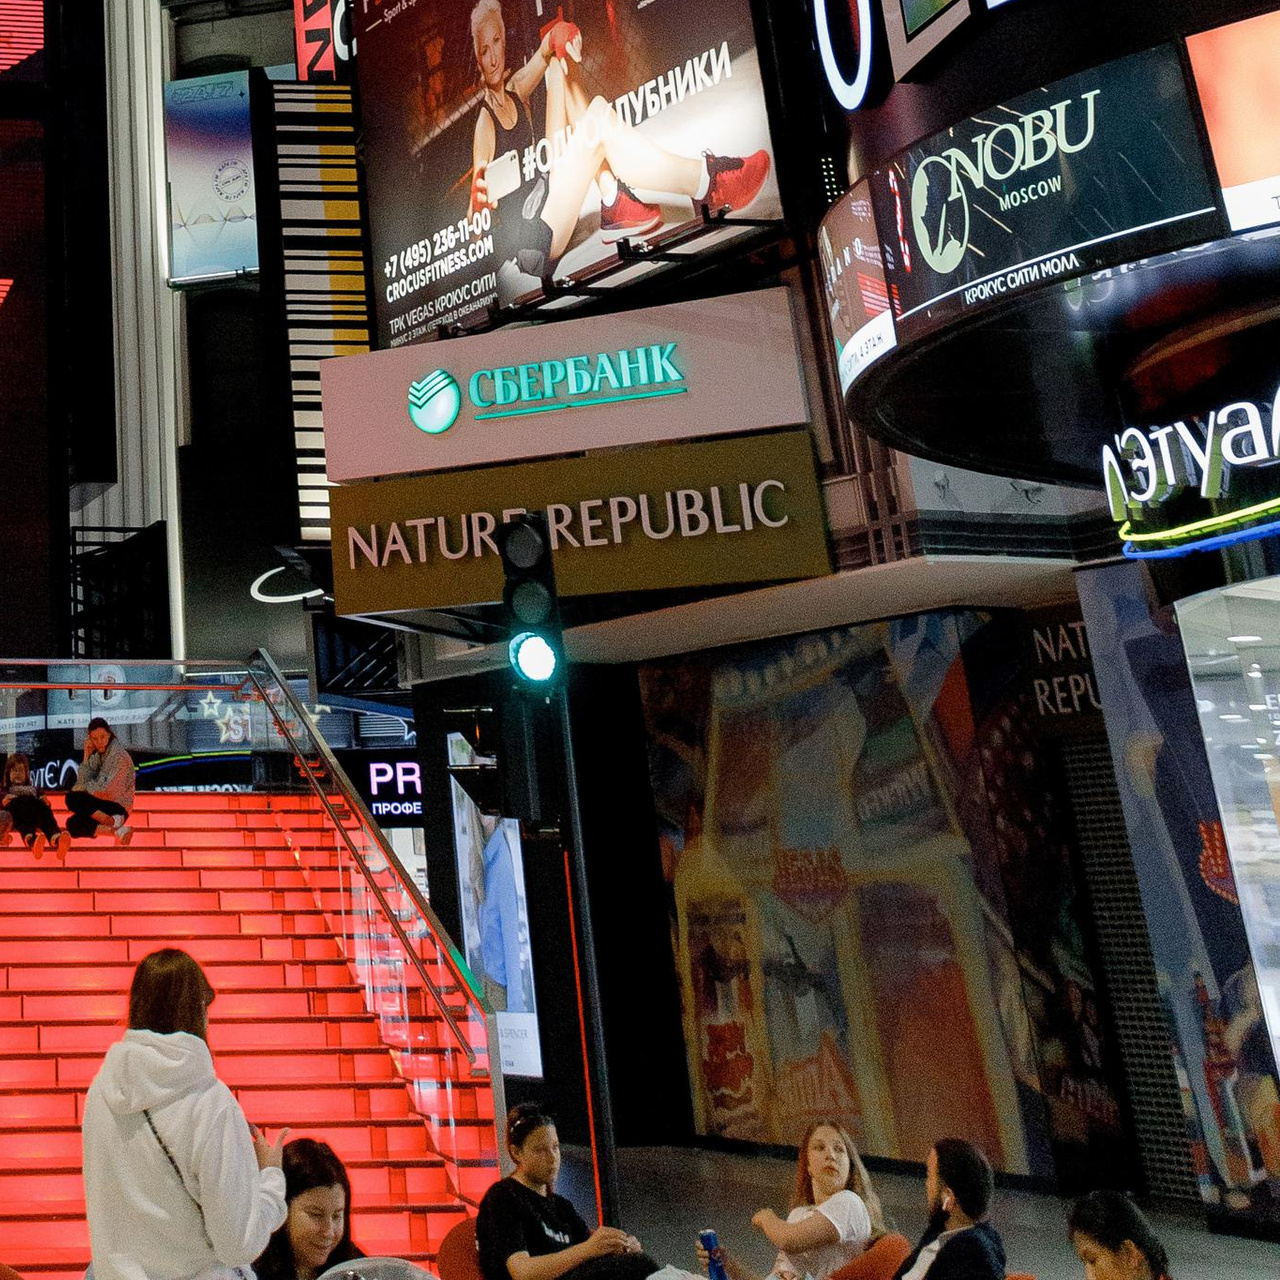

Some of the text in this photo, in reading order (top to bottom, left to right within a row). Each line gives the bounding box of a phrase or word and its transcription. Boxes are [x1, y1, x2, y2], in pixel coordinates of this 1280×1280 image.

[384, 2, 401, 23] Sport
[942, 89, 1101, 201] NOBU
[999, 175, 1062, 211] MOSCOW
[384, 207, 491, 278] +7 (495) 236-11-00
[386, 234, 494, 303] CROCUSFITNESS.COM
[389, 271, 497, 335] ТРК VEGAS КРОКУС СИТИ
[965, 252, 1079, 304] КРОКУС СИТИ МОЛЛ
[468, 343, 684, 408] СБЕРБАНК
[546, 479, 789, 552] REPUBLIC
